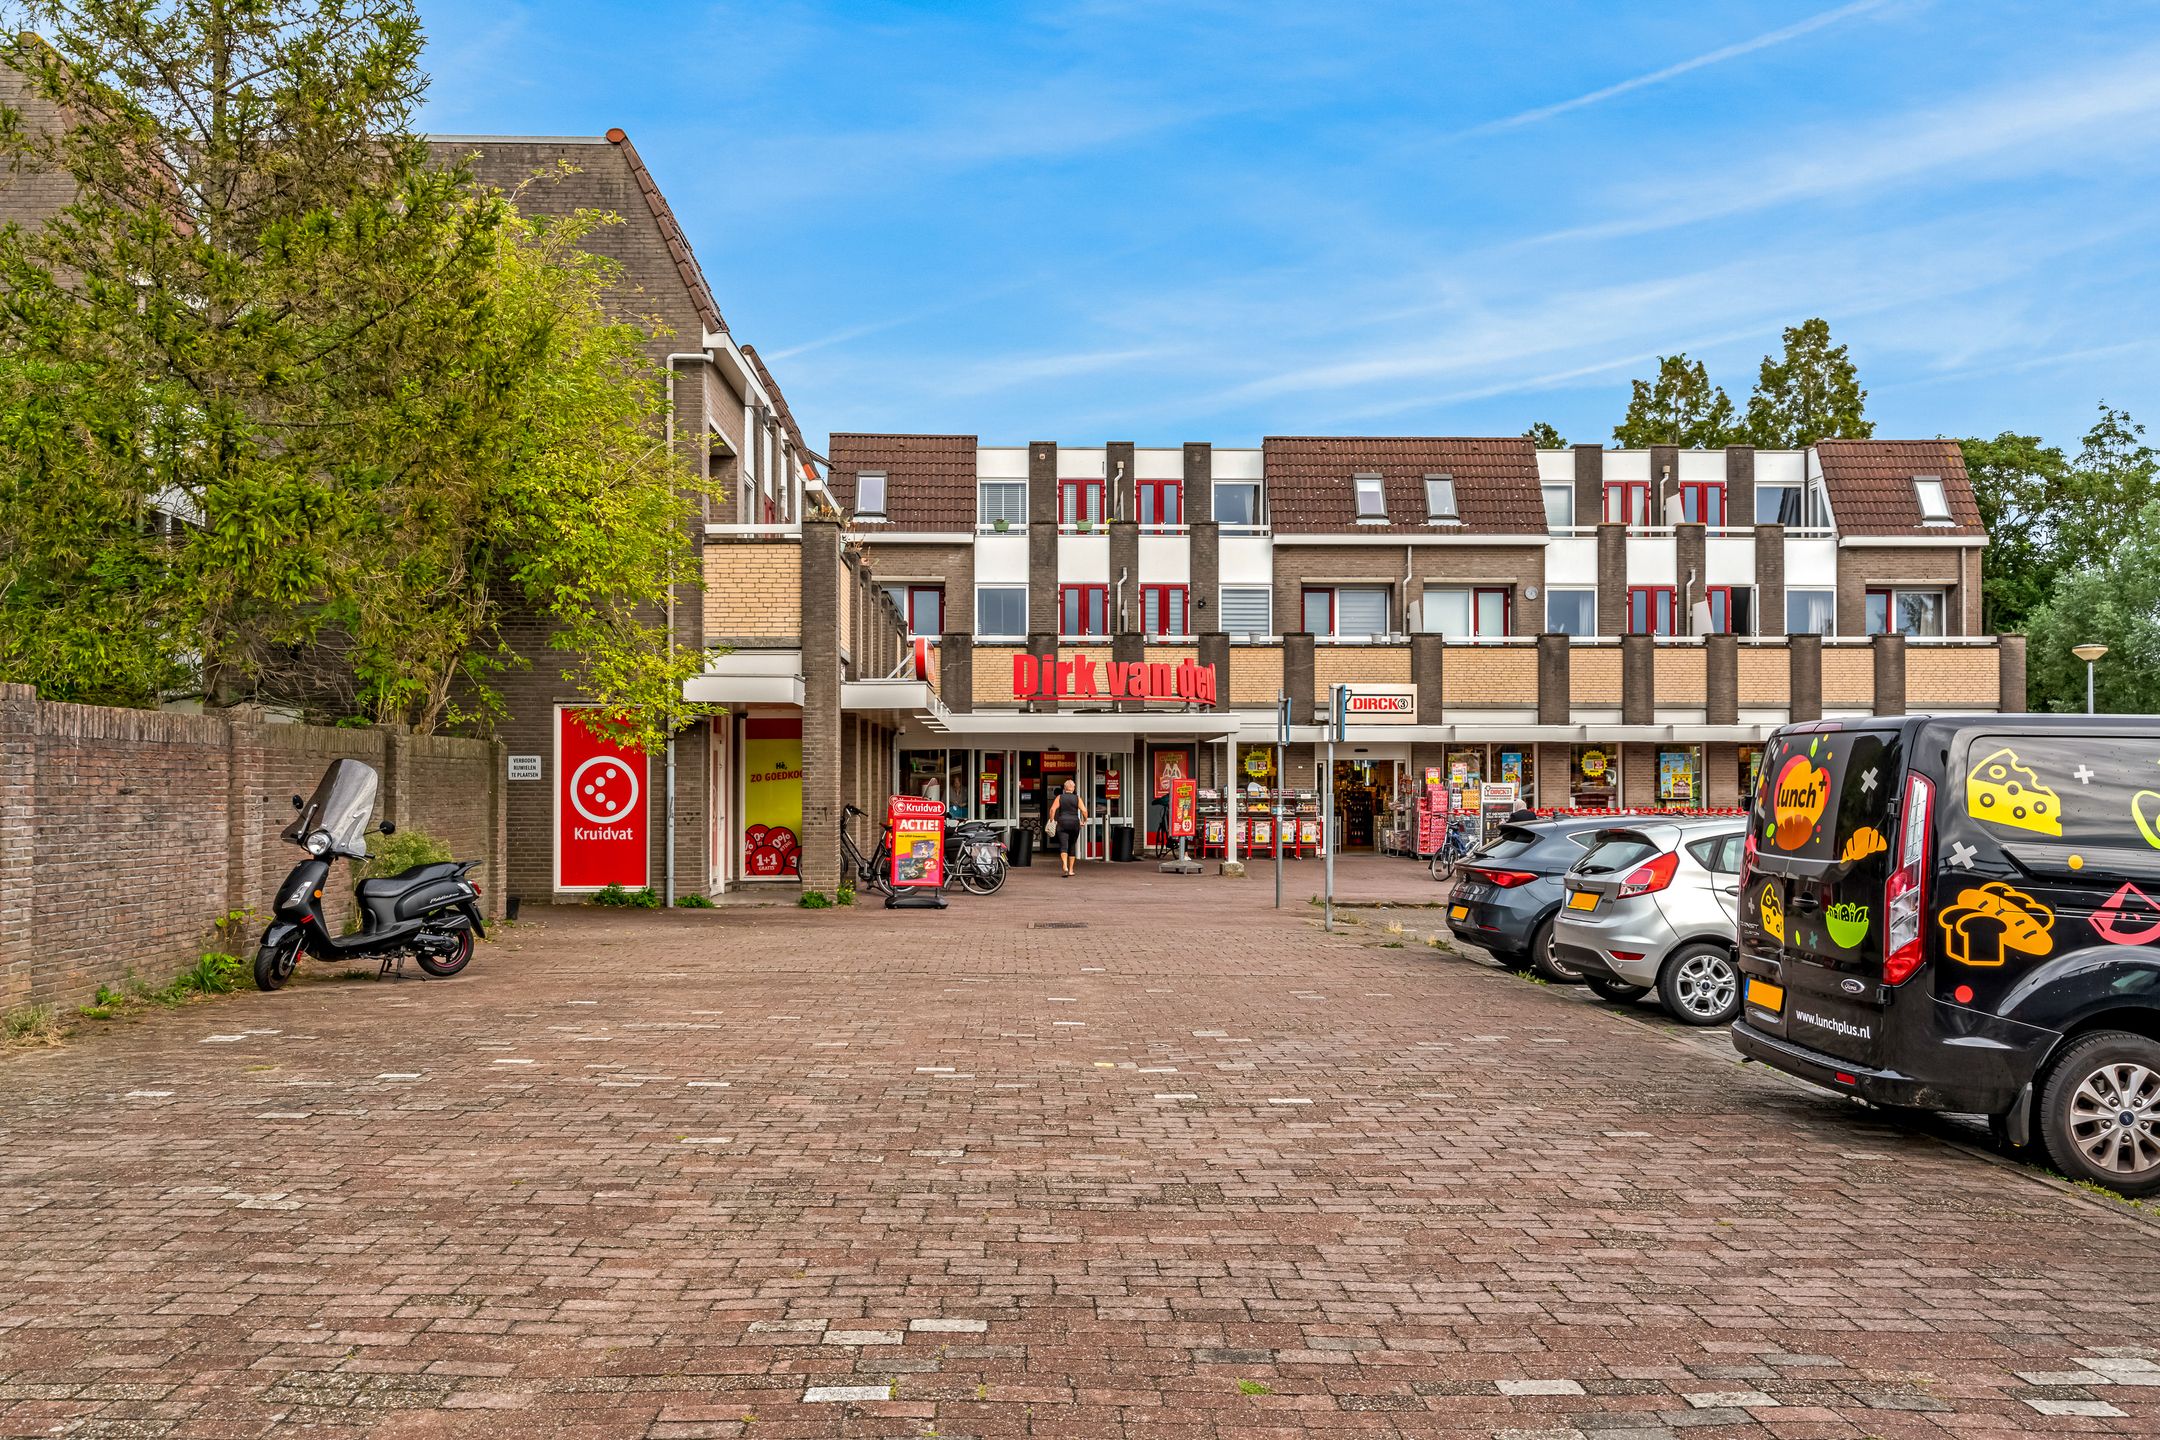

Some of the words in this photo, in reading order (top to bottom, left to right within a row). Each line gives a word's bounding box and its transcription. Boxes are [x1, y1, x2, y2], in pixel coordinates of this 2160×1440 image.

[1013, 654, 1098, 696] Dirk
[1106, 661, 1172, 697] van
[750, 774, 762, 783] ZO
[906, 803, 942, 813] Kruidvat
[899, 819, 940, 831] ACTIE!
[574, 826, 634, 841] Kruidvat
[756, 853, 778, 867] 1+1
[1795, 1009, 1871, 1040] www.lunchplus.nl
